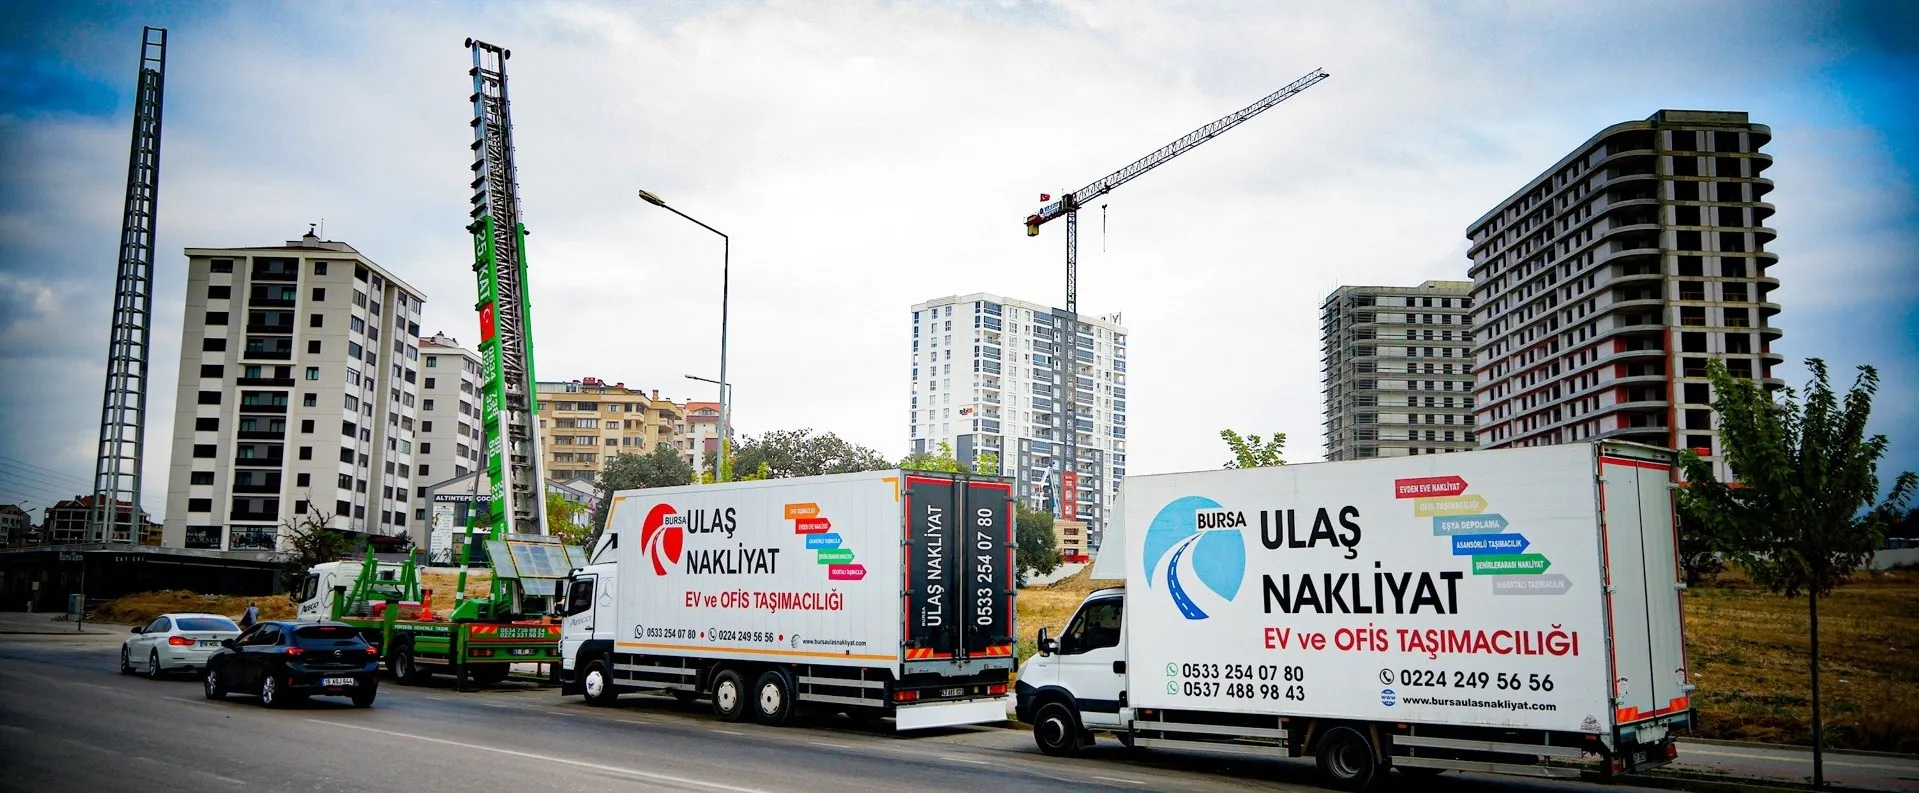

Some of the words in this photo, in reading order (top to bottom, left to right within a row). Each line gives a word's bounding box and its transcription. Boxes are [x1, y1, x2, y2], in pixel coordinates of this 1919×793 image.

[479, 263, 490, 300] KAT
[1400, 485, 1419, 493] EVDEN
[1420, 484, 1431, 492] EVE
[1432, 482, 1460, 491] NAKLİYAT
[665, 516, 686, 525] BURSA
[687, 507, 736, 538] ULAŞ
[977, 508, 992, 527] 80
[1198, 511, 1247, 529] BURSA
[1442, 522, 1460, 531] EŞYA
[1461, 520, 1500, 529] DEPOLAMA
[924, 505, 942, 580] NAKLİYAT
[977, 532, 992, 550] 07
[1260, 506, 1361, 560] ULAŞ
[1456, 540, 1487, 549] ASANSÖRLÜ
[1488, 540, 1522, 549] TAŞIMACILIK
[686, 542, 780, 574] NAKLİYAT
[1476, 560, 1517, 570] ŞEHİRLERARASI
[1518, 559, 1544, 568] NAKLİYAT
[977, 555, 992, 583] 254
[1262, 561, 1463, 614] NAKLİYAT
[685, 592, 702, 607] EV
[704, 595, 718, 608] ve
[720, 588, 750, 608] OFİS
[754, 588, 843, 614] TAŞIMACILIĞI
[927, 584, 944, 626] ULAŞ
[977, 588, 992, 626] 0533
[647, 628, 662, 638] 0533
[664, 628, 676, 638] 254
[678, 629, 686, 639] 07
[688, 630, 696, 639] 80
[719, 630, 736, 640] 0224
[738, 631, 751, 641] 249
[754, 632, 762, 642] 56
[764, 632, 774, 642] 56
[1264, 628, 1290, 649] EV
[1297, 632, 1326, 650] ve
[1334, 622, 1388, 652] OFİS
[1396, 624, 1579, 660] TAŞIMACILIĞI
[1182, 663, 1219, 678] 0533
[1225, 664, 1253, 680] 254
[1258, 665, 1277, 680] 07
[1284, 666, 1304, 682] 80
[1400, 669, 1447, 687] 0224
[1454, 671, 1489, 689] 249
[1497, 673, 1522, 691] 56
[1529, 674, 1554, 692] 56
[1184, 682, 1220, 697] 0537
[1226, 683, 1254, 699] 488
[1260, 684, 1279, 700] 98
[1285, 685, 1305, 701] 43
[1402, 696, 1557, 712] www.bursaulasnakliyat.com
